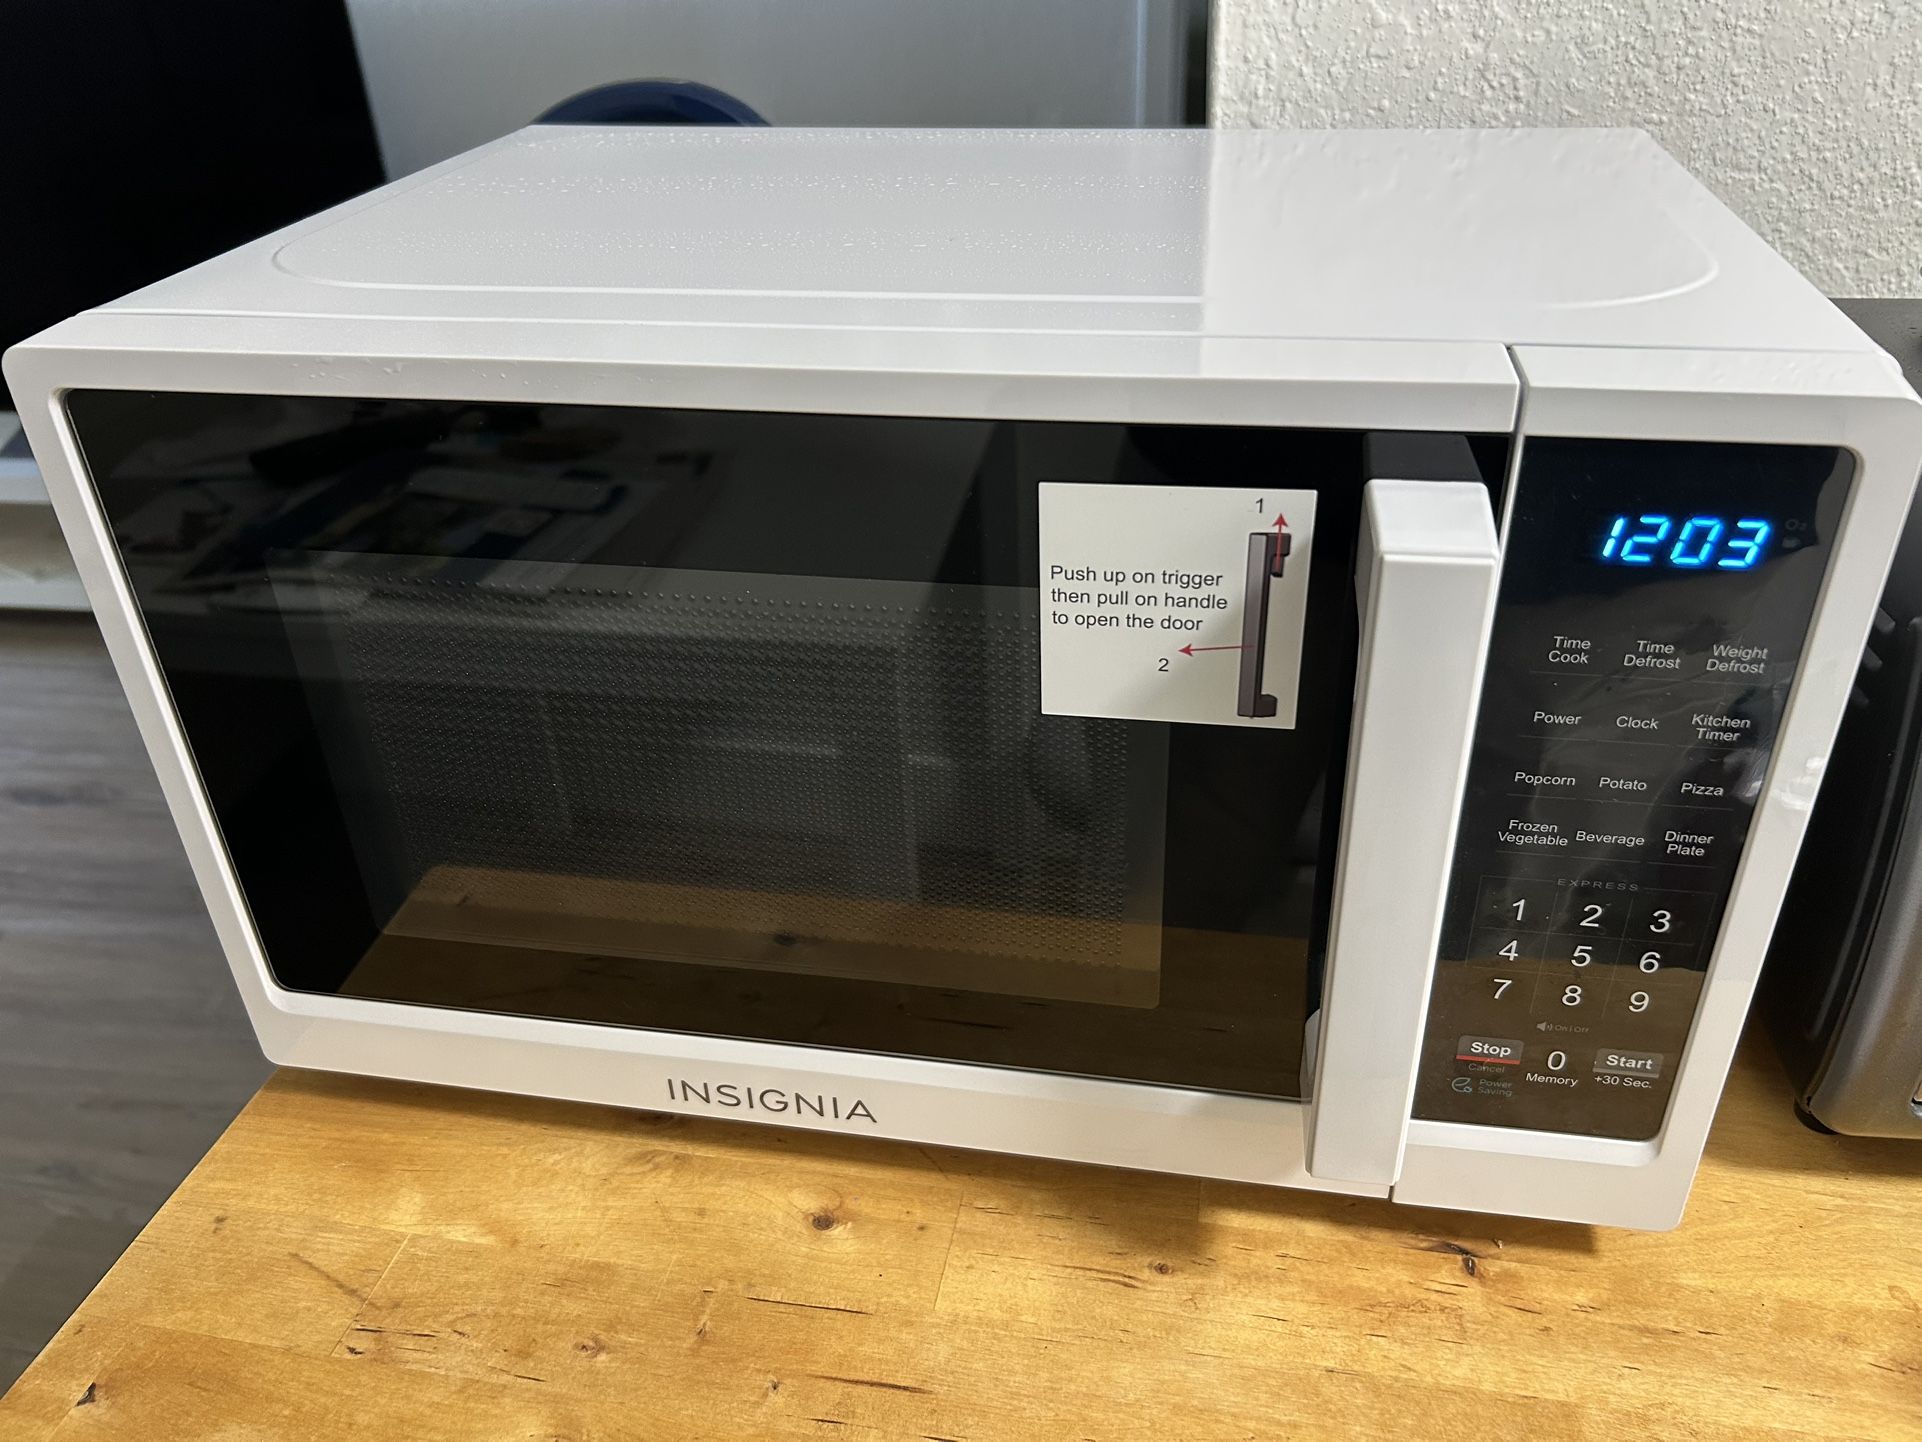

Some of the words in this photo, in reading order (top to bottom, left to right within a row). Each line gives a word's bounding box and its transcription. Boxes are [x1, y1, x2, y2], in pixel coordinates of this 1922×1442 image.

[1255, 497, 1264, 514] 1
[1602, 515, 1772, 569] 1203
[1050, 565, 1097, 582] Push
[1103, 570, 1126, 587] up
[1132, 572, 1156, 585] on
[1161, 570, 1223, 589] trigger
[1050, 588, 1091, 604] then
[1097, 590, 1129, 608] pull
[1134, 594, 1158, 607] on
[1164, 592, 1228, 610] handle
[1052, 611, 1069, 625] to
[1074, 614, 1120, 630] open
[1125, 613, 1154, 629] the
[1160, 615, 1204, 631] door
[1553, 635, 1592, 650] Time
[1636, 640, 1675, 655] Time
[1548, 650, 1590, 665] Cook
[1712, 643, 1769, 661] Weight
[1158, 657, 1170, 672] 2
[1623, 653, 1681, 670] Defrost
[1706, 658, 1766, 675] Defrost
[1533, 711, 1582, 726] Power
[1616, 715, 1659, 730] Clock
[1692, 713, 1751, 730] Kitchen
[1695, 727, 1741, 743] Timer
[1514, 771, 1576, 789] Popcorn
[1598, 776, 1647, 792] Potato
[1680, 782, 1724, 797] Pizza
[1508, 819, 1558, 834] Frozen
[1497, 831, 1568, 848] Vegetable
[1575, 830, 1645, 848] Beverage
[1664, 830, 1714, 846] Dinner
[1666, 843, 1705, 858] Plate
[1557, 878, 1640, 892] EXPRESS
[1511, 898, 1526, 921] 1
[1579, 904, 1603, 928] 2
[1650, 910, 1672, 933] 3
[1498, 940, 1519, 962] 4
[1571, 945, 1593, 967] 5
[1639, 951, 1661, 974] 6
[1493, 978, 1512, 1000] 7
[1562, 984, 1582, 1006] 8
[1629, 991, 1650, 1013] 9
[1470, 1041, 1512, 1057] Stop
[1468, 1063, 1505, 1073] Cancel
[1547, 1051, 1566, 1071] 0
[1605, 1054, 1653, 1070] Start
[1479, 1078, 1513, 1089] Power
[1525, 1072, 1578, 1088] Memory
[1594, 1075, 1620, 1087] +30
[1622, 1076, 1652, 1089] Sec.
[667, 1078, 878, 1124] INSIGNIA
[1478, 1087, 1513, 1098] Saving
